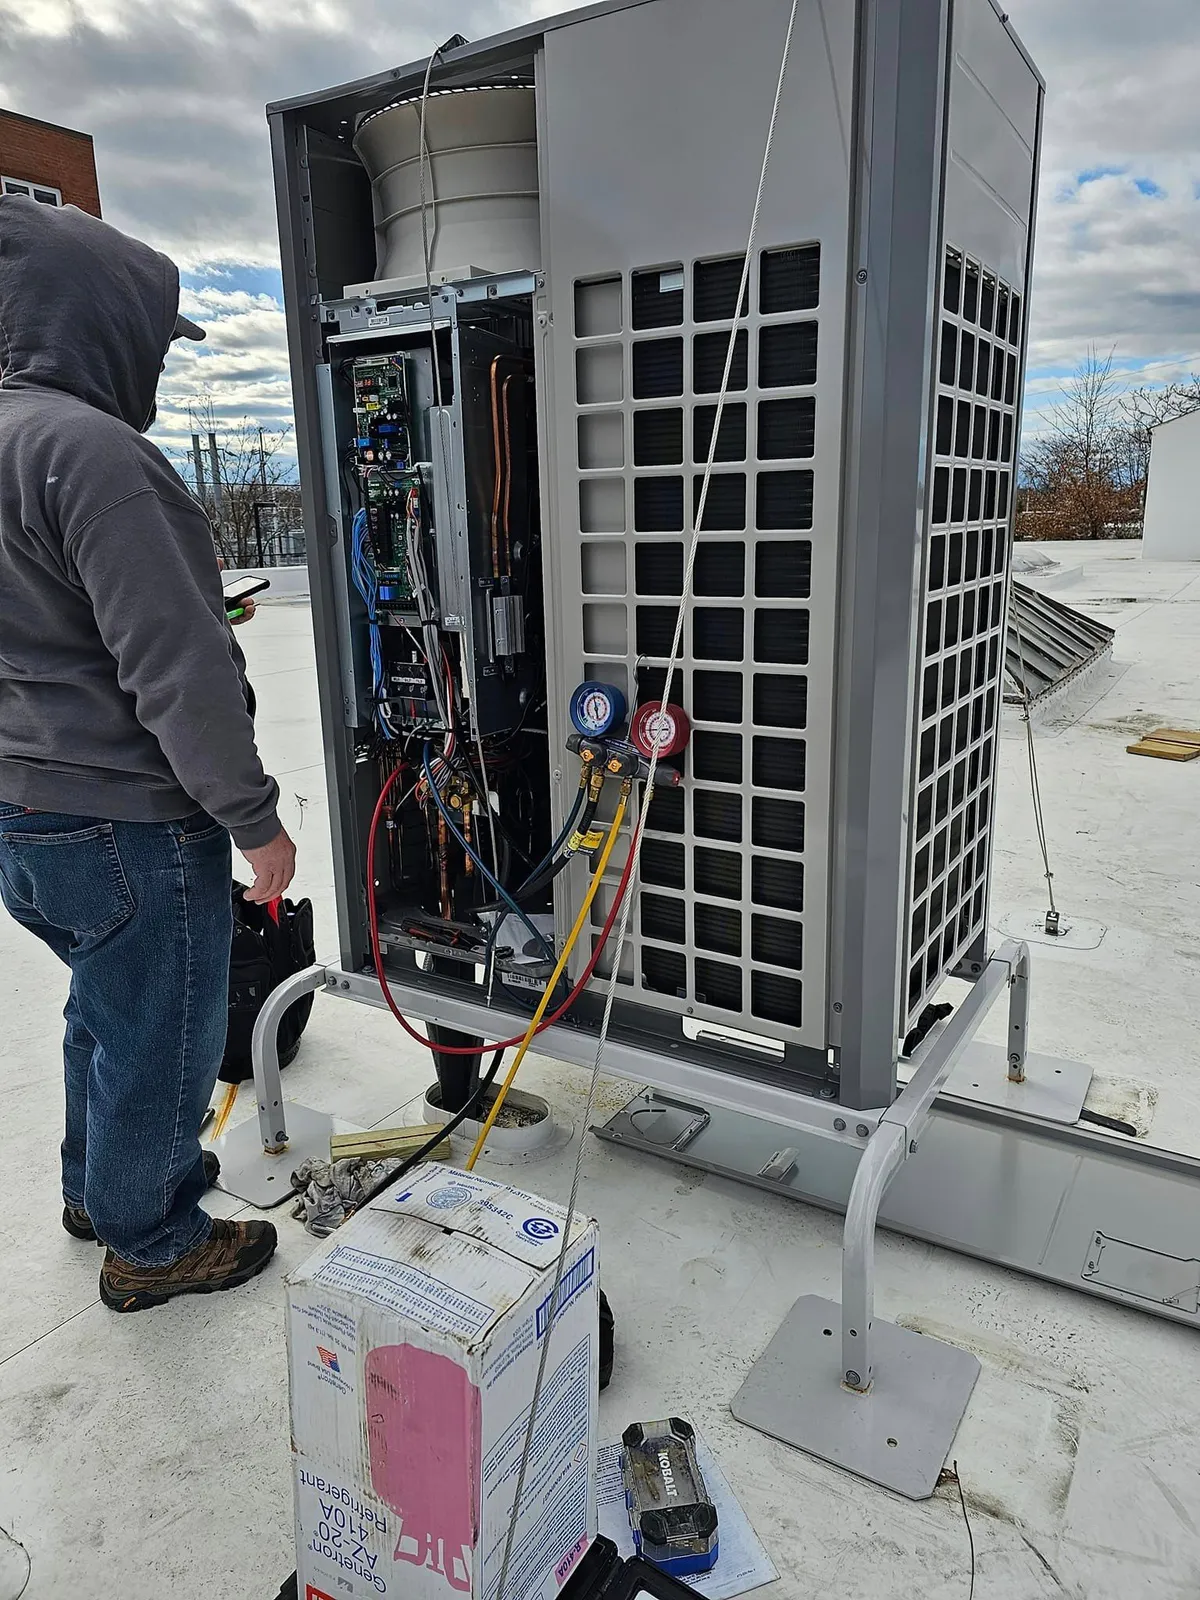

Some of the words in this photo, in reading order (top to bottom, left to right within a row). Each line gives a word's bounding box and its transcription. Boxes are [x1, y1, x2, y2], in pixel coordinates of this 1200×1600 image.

[657, 1452, 678, 1497] KOBALT
[300, 1469, 387, 1533] Refrigerant
[319, 1498, 369, 1541] 410A
